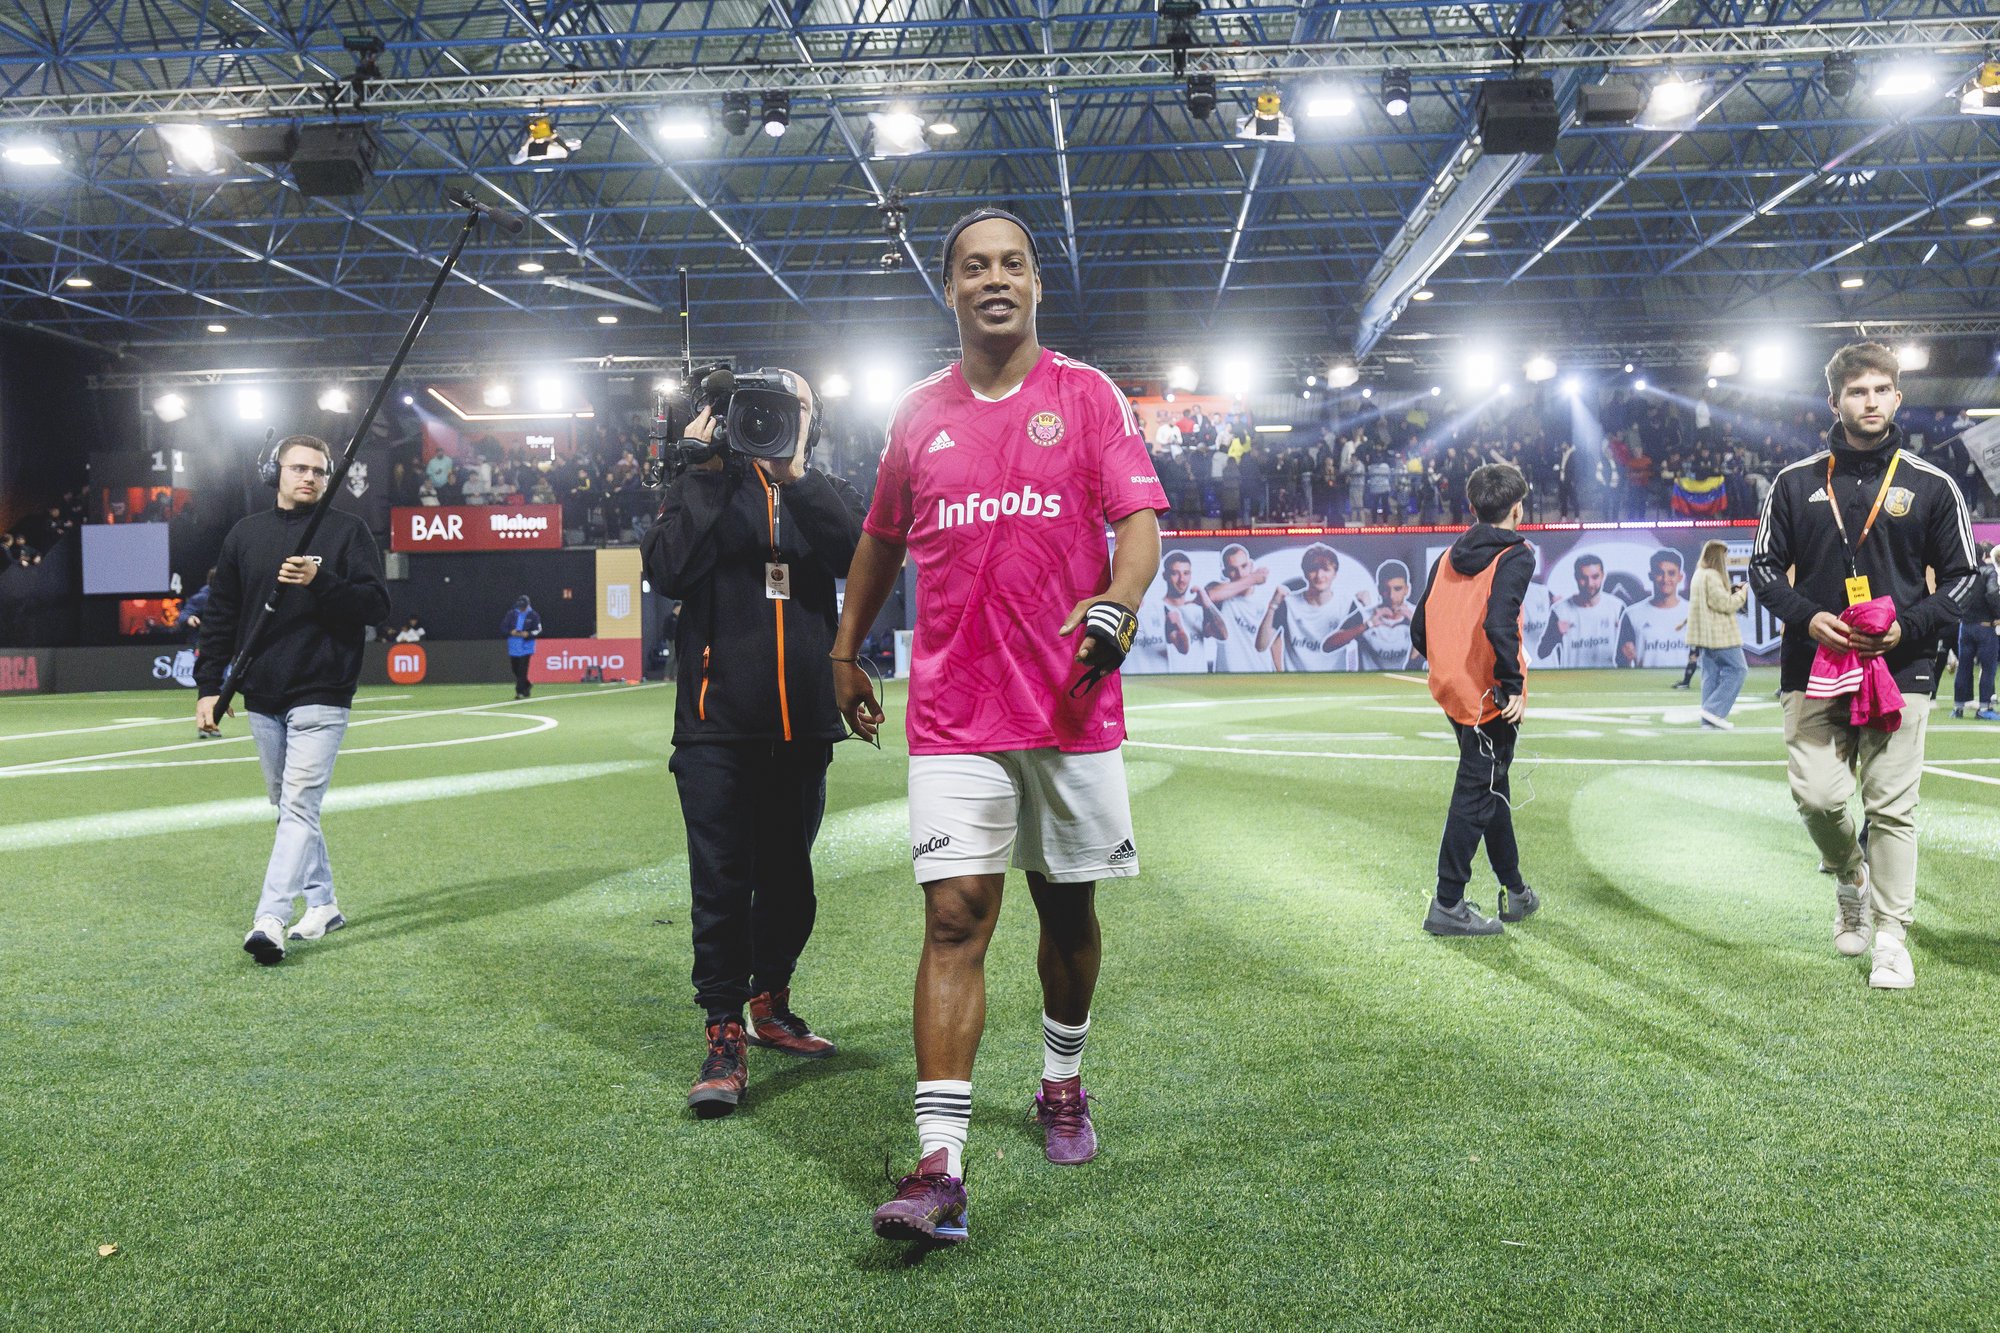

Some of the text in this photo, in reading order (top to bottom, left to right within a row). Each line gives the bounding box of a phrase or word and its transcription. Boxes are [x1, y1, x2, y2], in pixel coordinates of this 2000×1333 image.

[411, 514, 464, 541] BAR
[490, 513, 548, 531] Mahou
[912, 836, 950, 861] ColaCao
